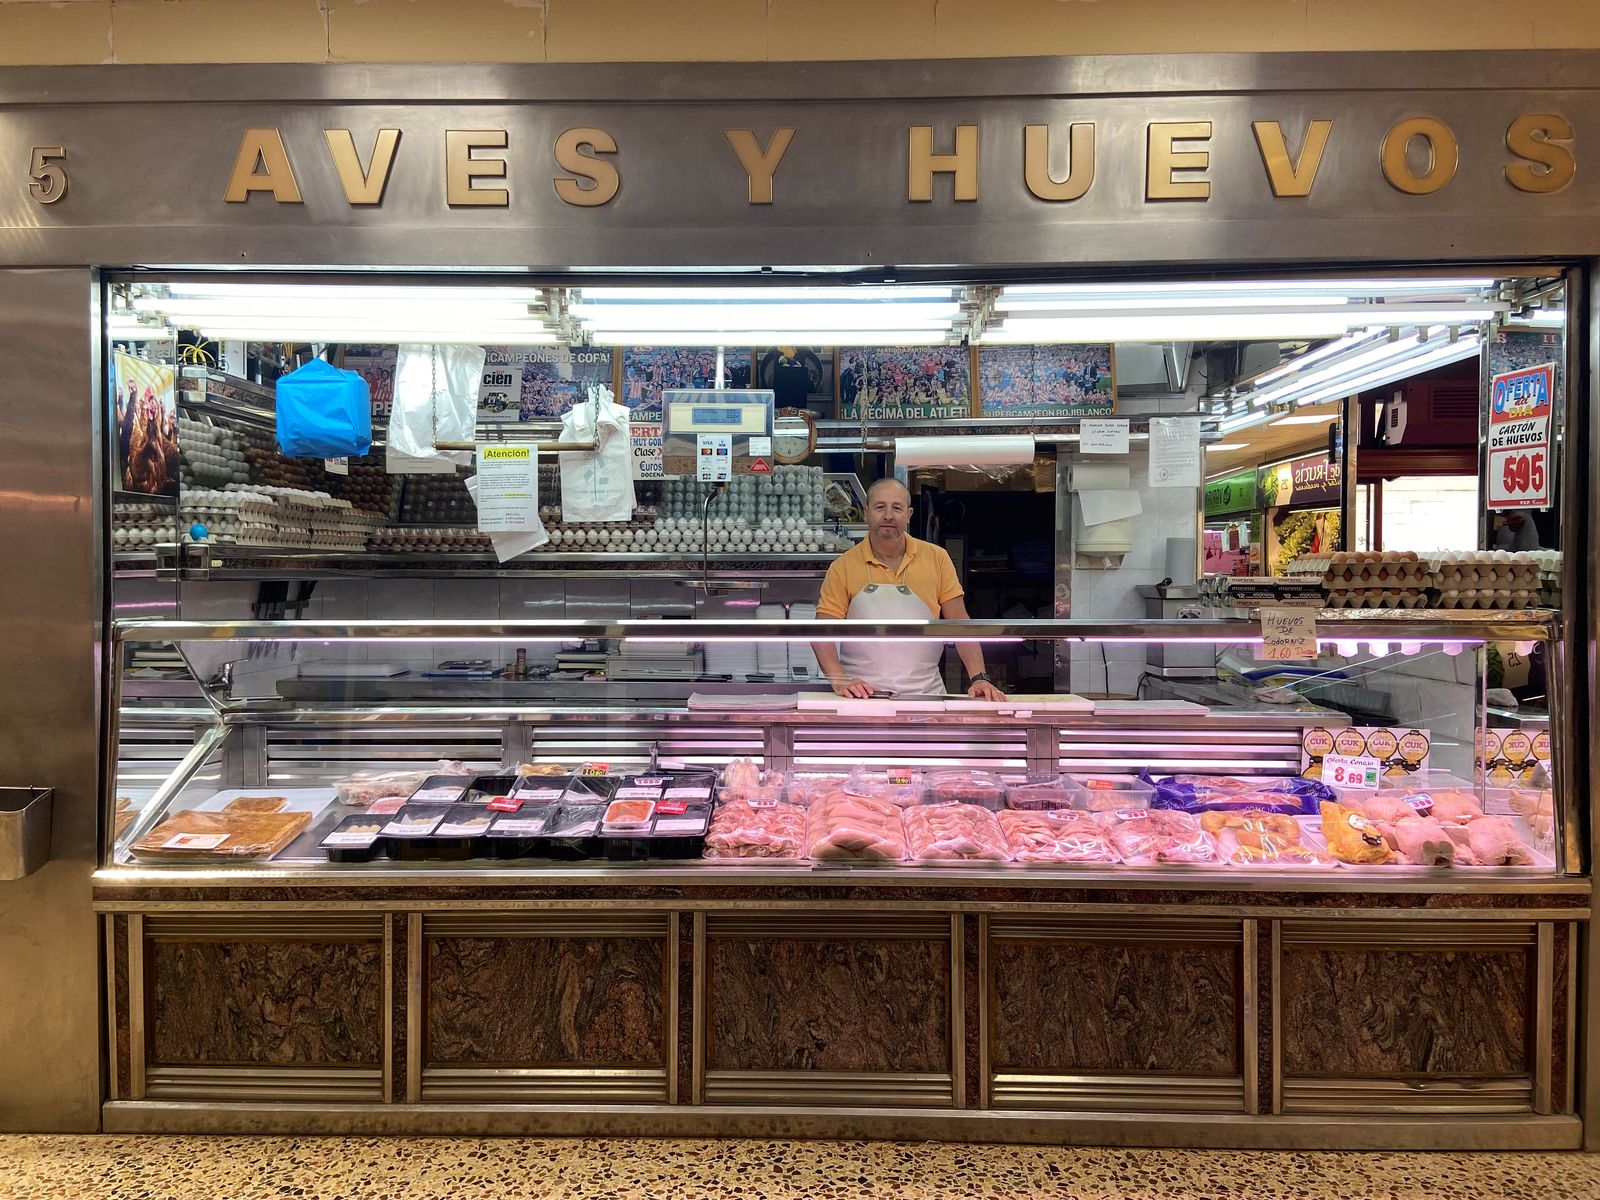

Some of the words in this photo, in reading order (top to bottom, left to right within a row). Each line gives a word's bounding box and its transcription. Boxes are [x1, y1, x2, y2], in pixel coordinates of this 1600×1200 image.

[224, 126, 621, 207] AVES
[724, 126, 797, 204] Y
[907, 112, 1576, 202] HUEVOS
[28, 145, 68, 204] 5
[560, 353, 575, 363] DE
[577, 352, 610, 363] COPA!
[483, 371, 513, 385] cien
[1493, 371, 1549, 414] OFERTA
[906, 408, 928, 419] DEL
[1498, 419, 1536, 436] CARTÓN
[1492, 436, 1504, 447] DE
[1506, 431, 1543, 445] HUEVOS
[484, 448, 530, 459] ¡Atención!
[634, 447, 656, 457] Clase
[1267, 612, 1304, 626] HUEVOS
[1275, 625, 1294, 634] DE
[1309, 738, 1328, 746] CUK
[1404, 741, 1423, 749] CUK
